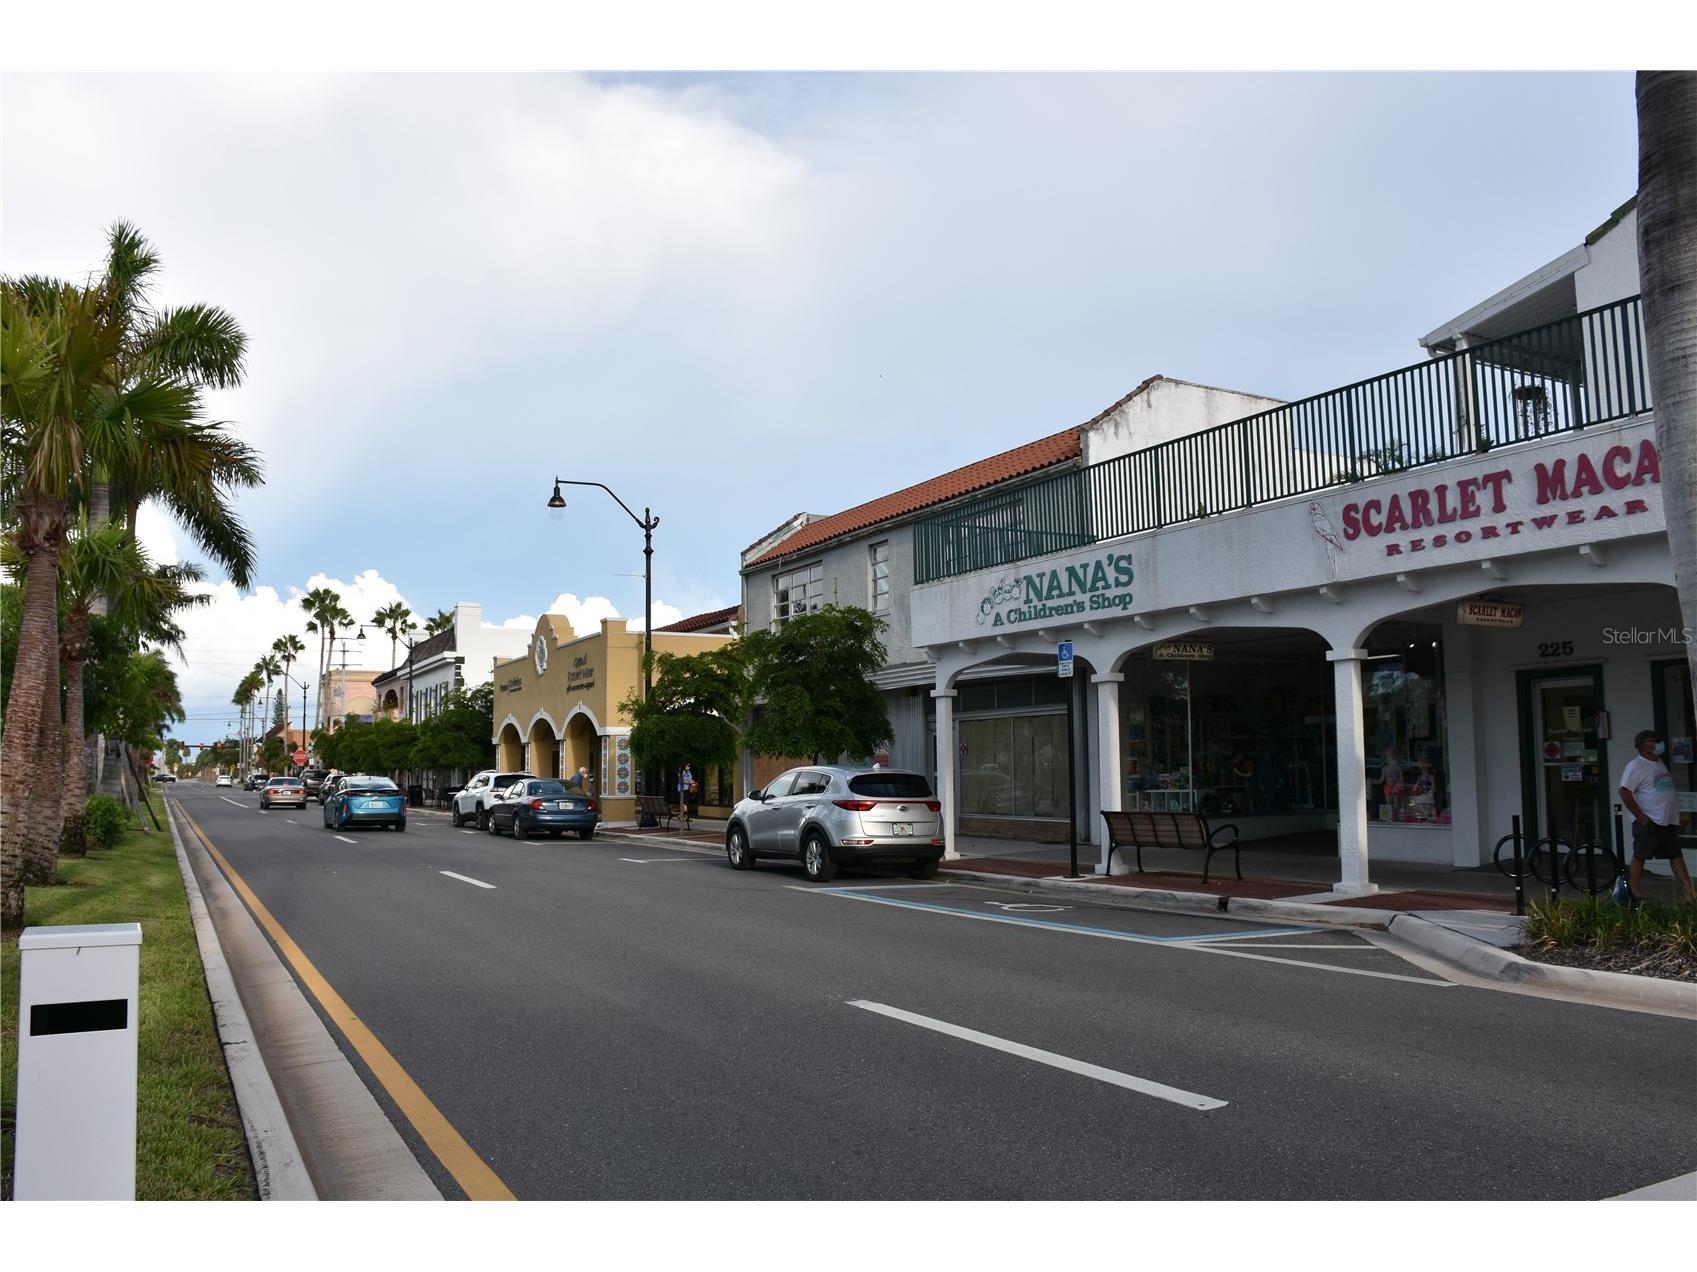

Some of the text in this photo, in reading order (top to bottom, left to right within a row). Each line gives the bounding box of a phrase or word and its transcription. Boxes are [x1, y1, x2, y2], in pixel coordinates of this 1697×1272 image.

[1342, 439, 1661, 541] SCARLET MACA
[1386, 498, 1649, 557] RESORTWEAR
[1023, 553, 1134, 604] NANA'S
[992, 592, 1133, 626] A Children's Shop
[1469, 604, 1498, 616] SCARLET
[1173, 644, 1213, 653] NANA'S
[1538, 641, 1574, 658] 225
